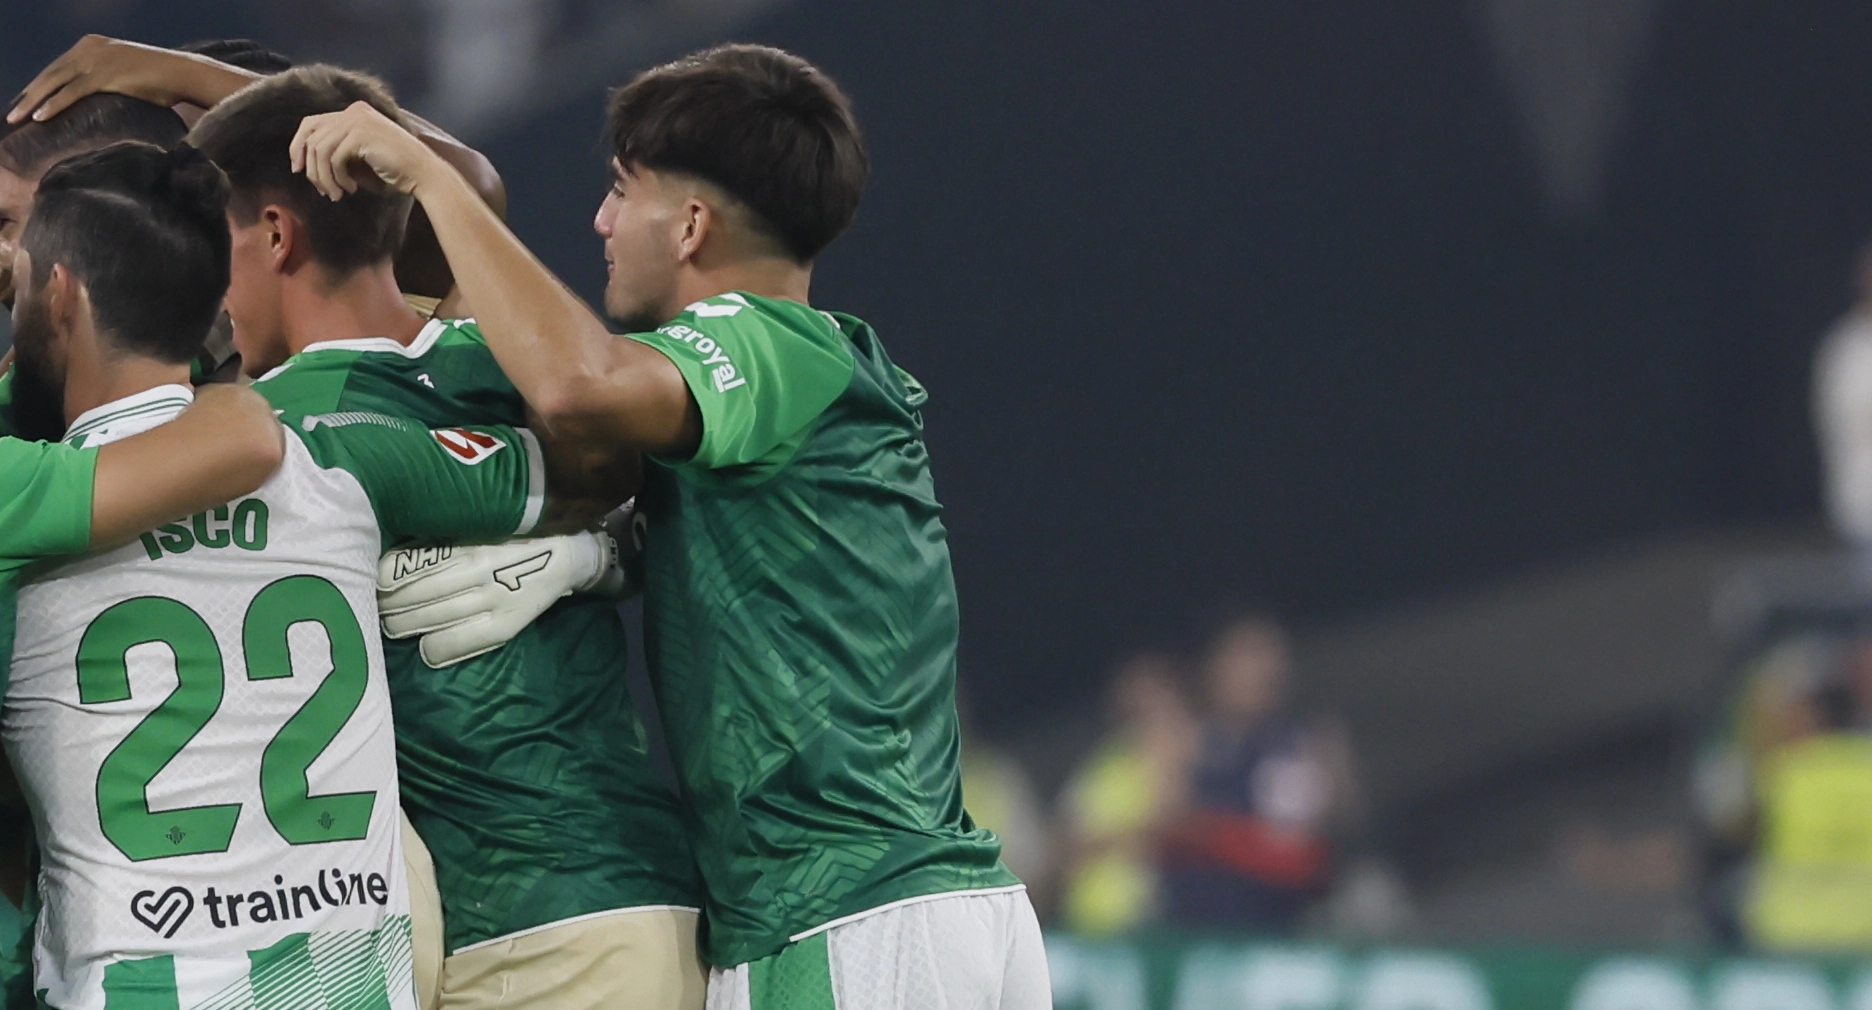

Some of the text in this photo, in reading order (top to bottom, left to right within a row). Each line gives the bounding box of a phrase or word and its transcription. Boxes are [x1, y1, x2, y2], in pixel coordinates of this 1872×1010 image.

[139, 498, 269, 561] ISCO
[75, 574, 378, 863] 22
[202, 867, 389, 929] trainline
